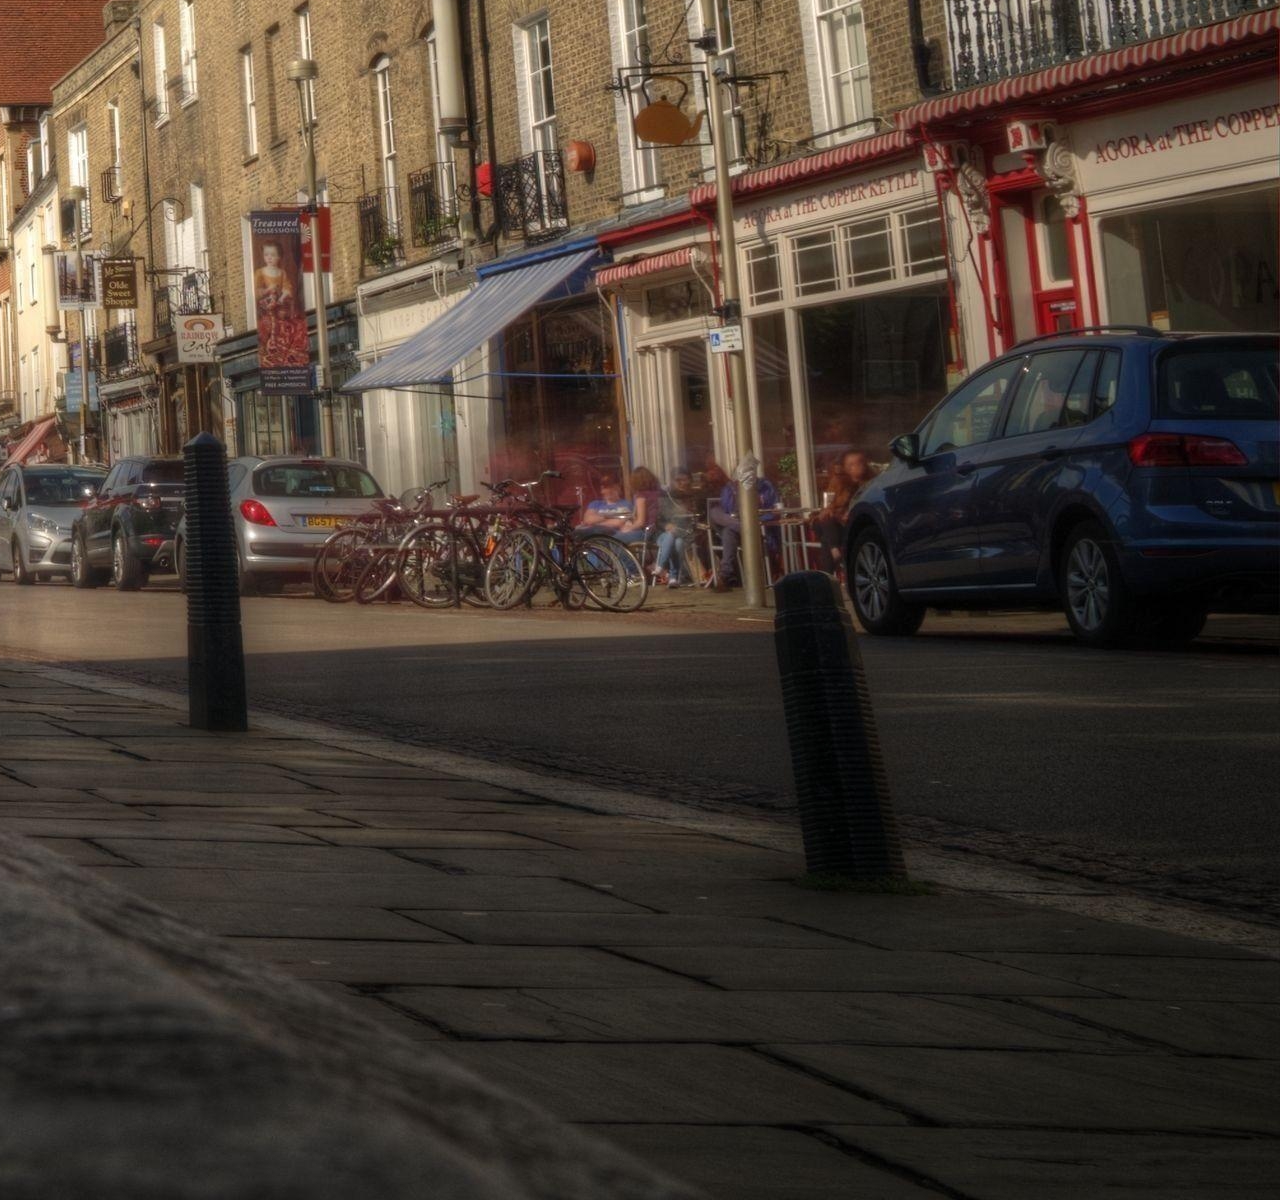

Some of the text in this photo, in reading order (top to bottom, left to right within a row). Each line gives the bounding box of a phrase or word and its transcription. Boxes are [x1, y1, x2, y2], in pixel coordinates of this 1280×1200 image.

[1095, 132, 1156, 164] AGORA
[1158, 133, 1173, 152] at
[1173, 119, 1213, 147] THE
[743, 168, 918, 229] AGORA at THE COPPER KETTLE
[253, 217, 298, 227] Treasured
[109, 281, 129, 290] Olde
[107, 290, 131, 298] Sweet
[105, 297, 135, 306] Shoppe
[181, 332, 218, 340] RAINBOW
